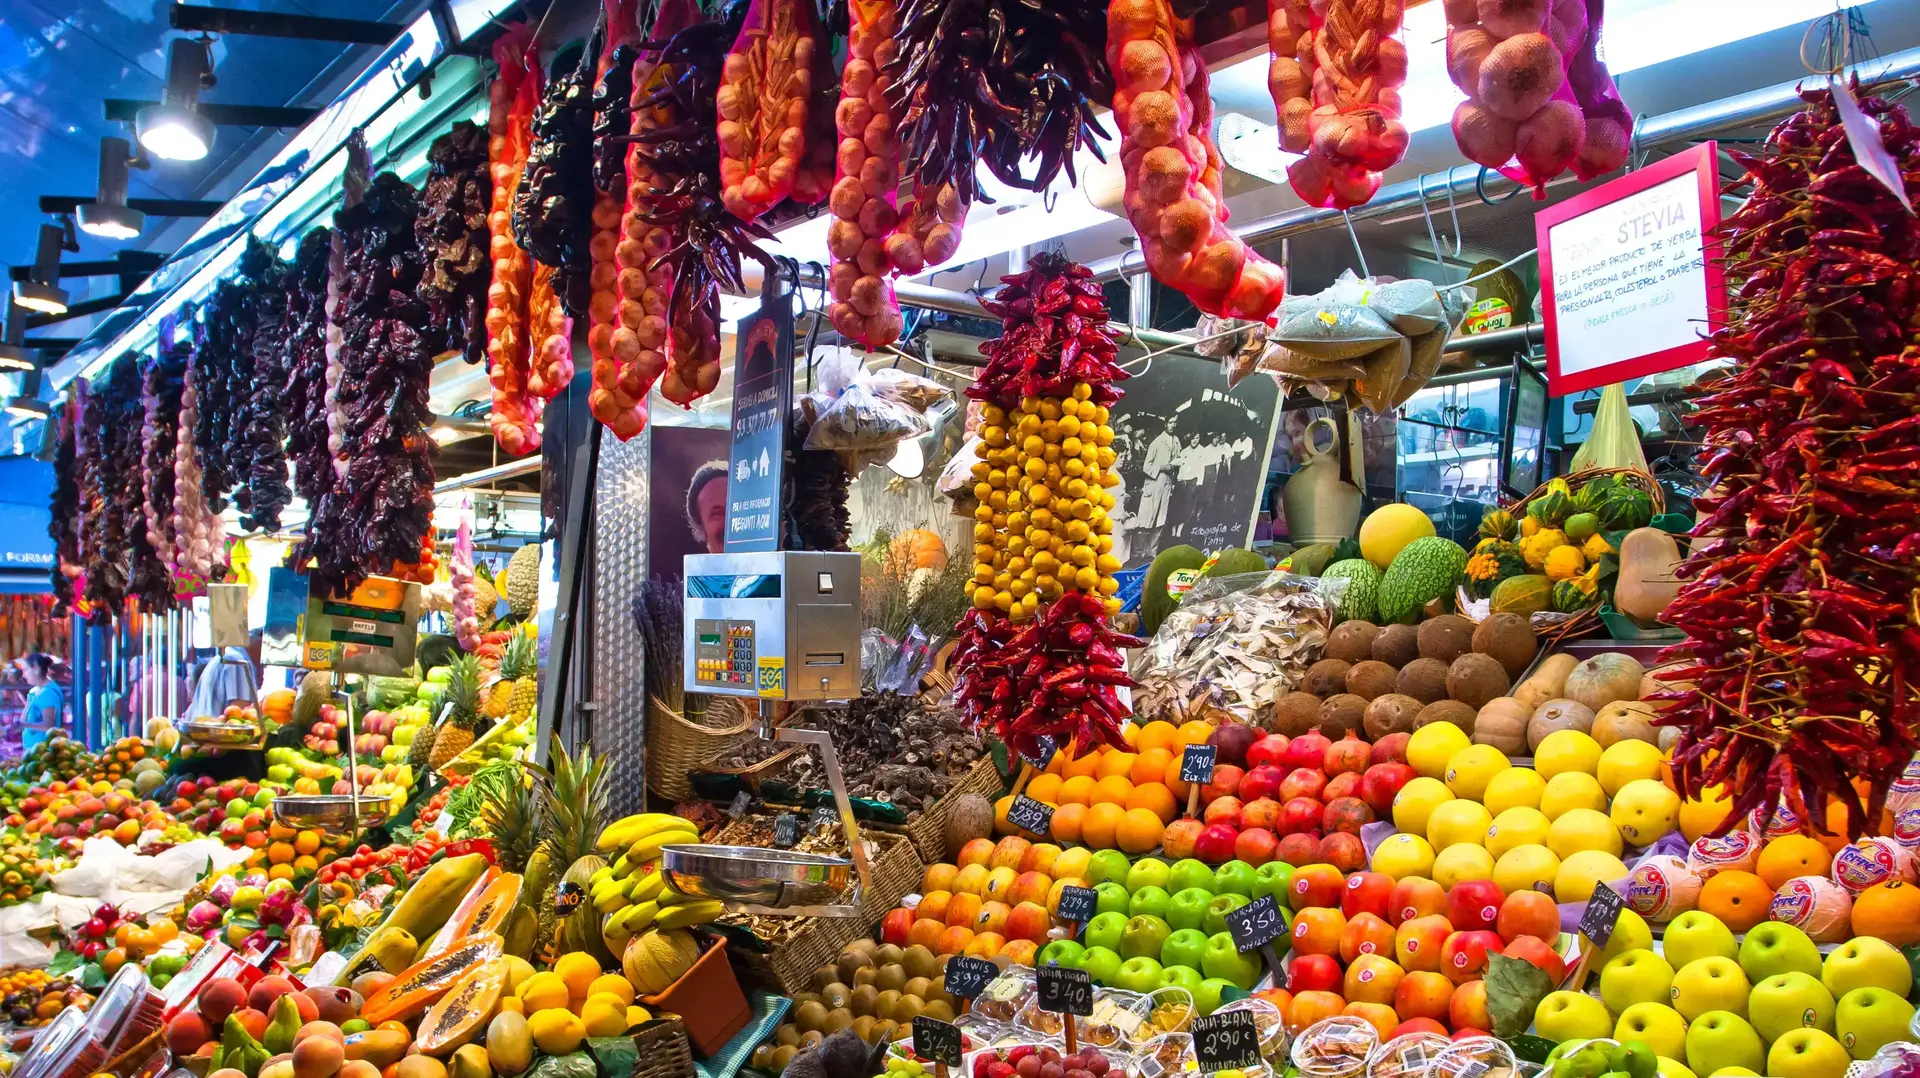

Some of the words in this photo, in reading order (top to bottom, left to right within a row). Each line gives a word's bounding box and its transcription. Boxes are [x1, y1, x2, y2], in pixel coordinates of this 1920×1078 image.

[1617, 203, 1685, 244] STEVIA
[1582, 258, 1606, 277] MEJOR
[1609, 247, 1645, 267] PRODUCTO
[1650, 240, 1662, 252] DE
[1667, 228, 1697, 247] YERBA
[1574, 287, 1583, 297] LA
[1584, 274, 1618, 293] PERSONA
[1622, 268, 1637, 279] QUE
[1640, 256, 1665, 273] TIENE
[1673, 250, 1685, 261] LA
[1614, 275, 1658, 296] COLESTEROL
[1666, 257, 1703, 278] DIABETES
[1611, 306, 1638, 319] FRESCA
[737, 418, 746, 439] 93
[766, 407, 777, 431] 77
[1231, 522, 1242, 532] de
[1183, 754, 1210, 774] 2'90
[1840, 846, 1889, 875] Torres
[1242, 907, 1275, 937] 3'50
[949, 971, 981, 989] 3'99
[1203, 1030, 1240, 1056] 2'90
[1244, 1031, 1251, 1040] €
